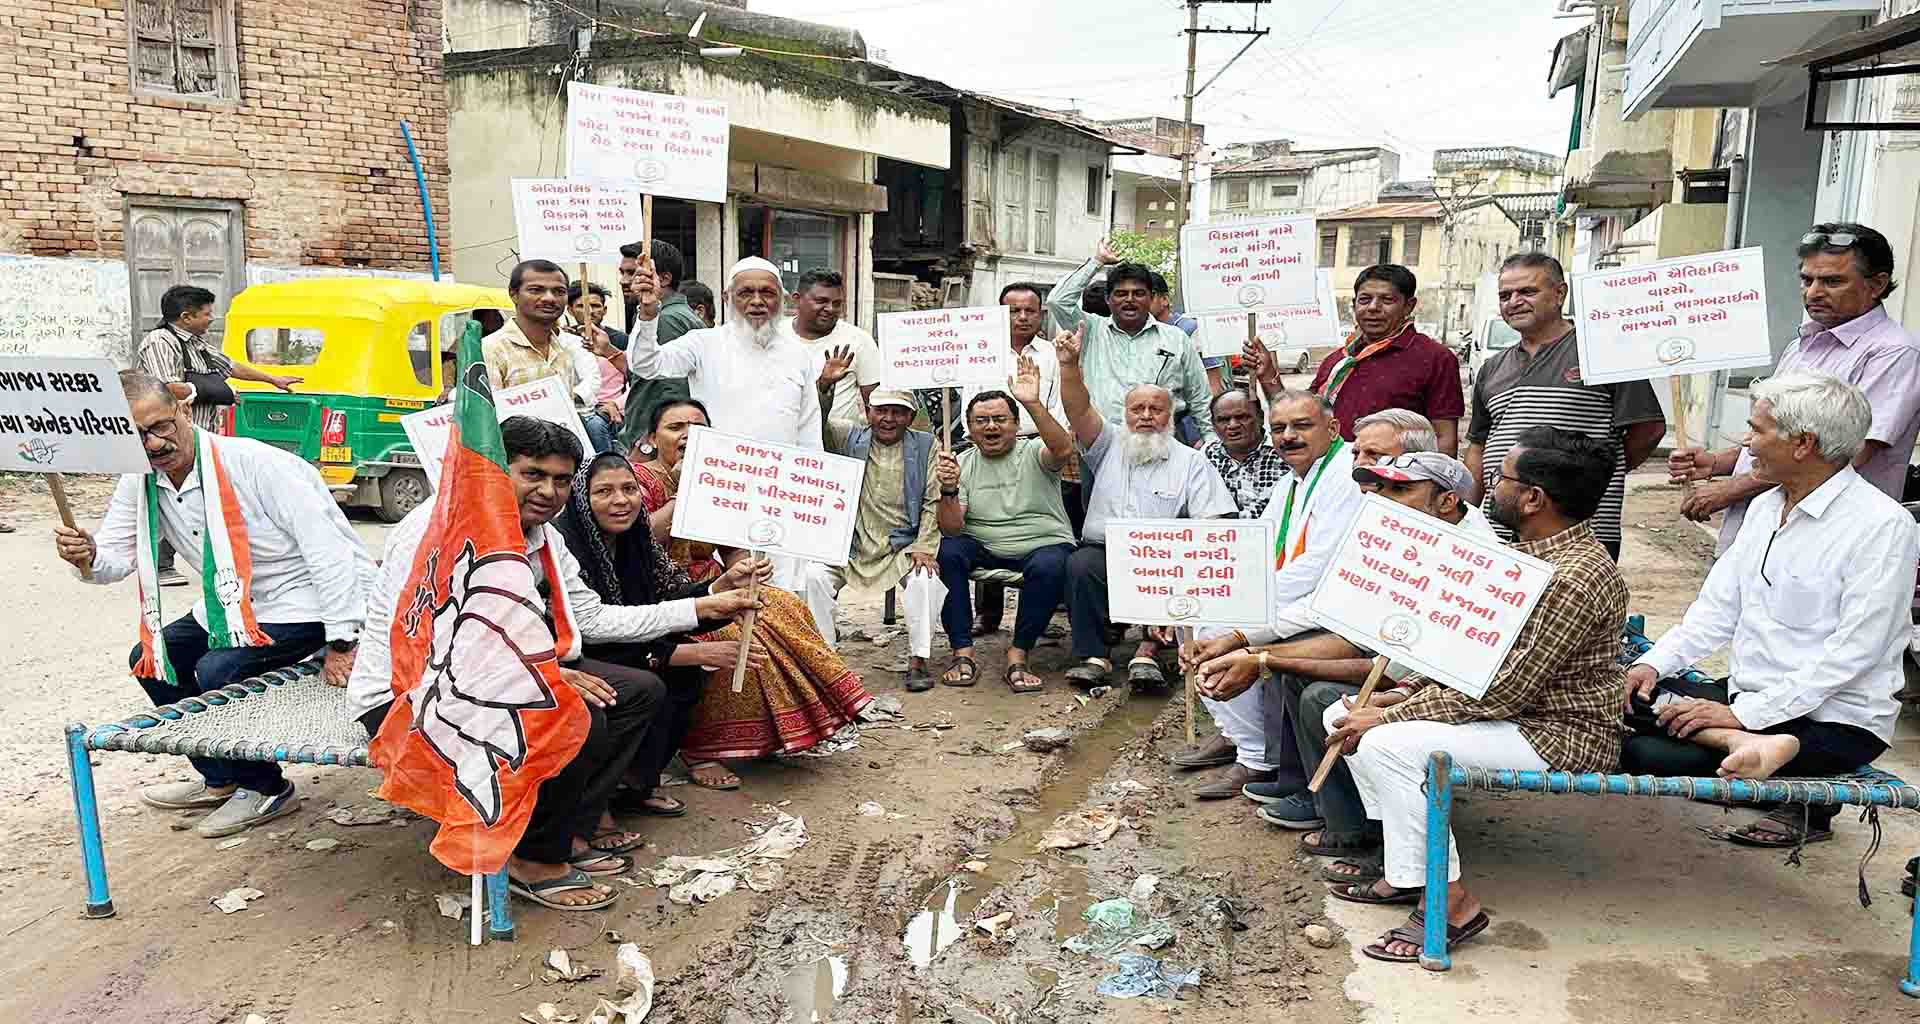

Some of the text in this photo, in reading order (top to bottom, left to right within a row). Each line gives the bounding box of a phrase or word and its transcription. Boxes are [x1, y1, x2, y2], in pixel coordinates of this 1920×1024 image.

[536, 198, 560, 207] તારા
[543, 208, 625, 220] વિકાસને બદલે
[544, 224, 627, 232] ખાડા જ ખાડા
[1268, 223, 1293, 236] નામે
[1219, 245, 1239, 255] મત
[1200, 252, 1302, 271] જનતાની આંખમાં
[1249, 269, 1281, 281] નાખી
[1602, 262, 1741, 289] પાટણનો ઐતિહાસિક
[902, 312, 985, 326] પાટણની પ્રજા
[1620, 309, 1728, 333] ભાજપનો કારસો
[899, 339, 989, 355] નગરપાલિકા છે
[967, 354, 997, 365] મસ્ત
[47, 371, 104, 393] સરકાર
[504, 388, 549, 407] ખાડા
[25, 407, 73, 435] અનેક
[71, 408, 135, 436] પરિવાર
[735, 443, 824, 470] ભાજપ તારા
[697, 472, 847, 512] વિકાસ ખીસ્સામાં ને
[711, 496, 828, 527] રસ્તા પર ખાડા
[1128, 528, 1237, 543] બનાવવી હતી
[1128, 544, 1171, 559] પેરિસ
[1379, 515, 1523, 583] રસ્તામાં ખાડા ને
[1132, 565, 1185, 578] બનાવી
[1356, 530, 1527, 610] ભુવા છે, ગલી ગલી
[1136, 584, 1231, 598] ખાડા નગરી
[1360, 553, 1498, 623] પાટણની પ્રજાના
[1337, 567, 1501, 649] મણકા જાય, હલી હલી
